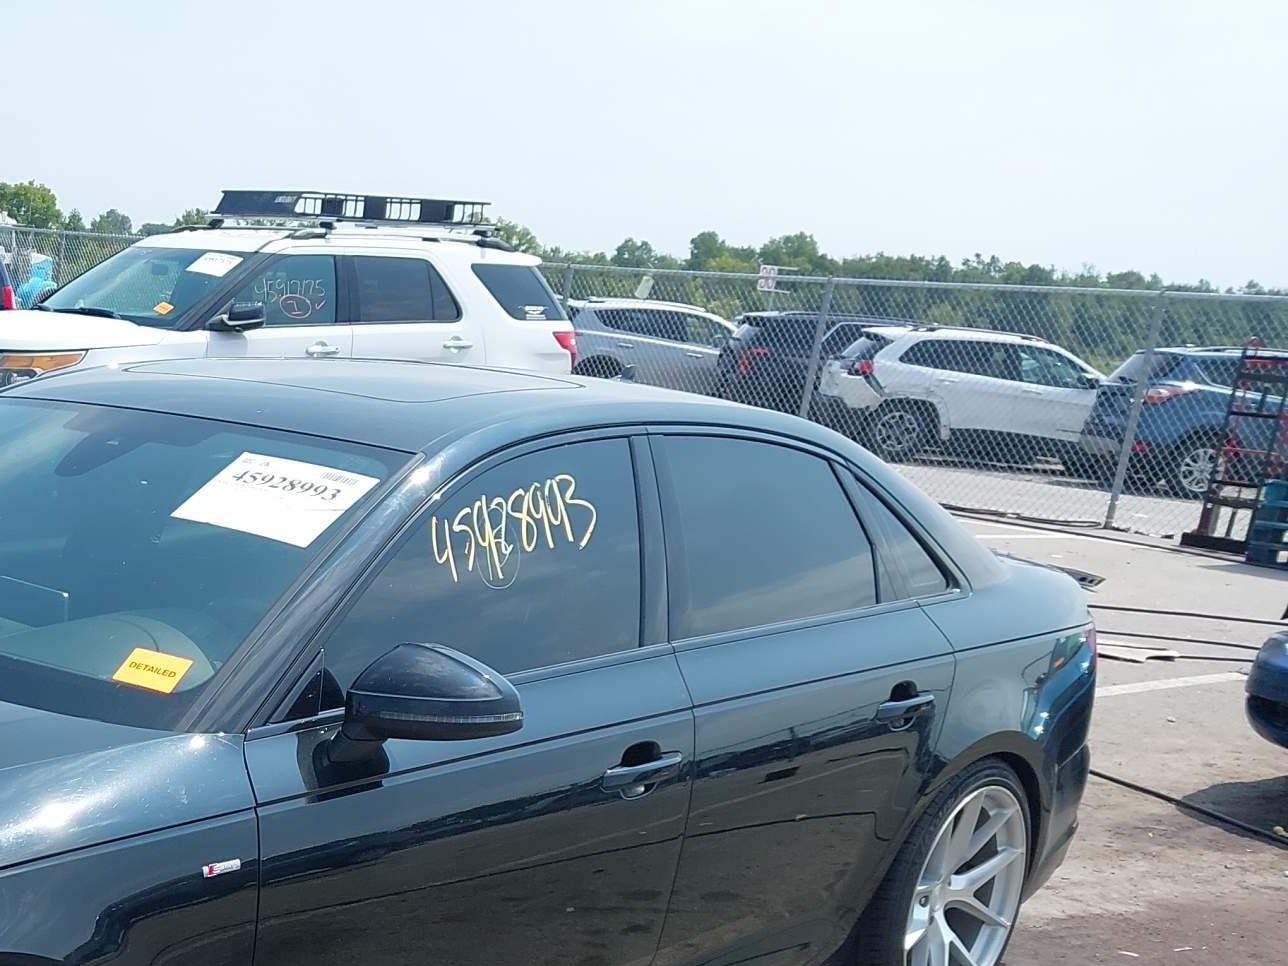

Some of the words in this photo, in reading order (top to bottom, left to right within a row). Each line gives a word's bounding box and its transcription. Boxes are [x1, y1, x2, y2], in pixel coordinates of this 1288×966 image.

[231, 469, 342, 502] 45928993
[431, 474, 597, 583] 45928993
[128, 661, 177, 678] DETAILED
